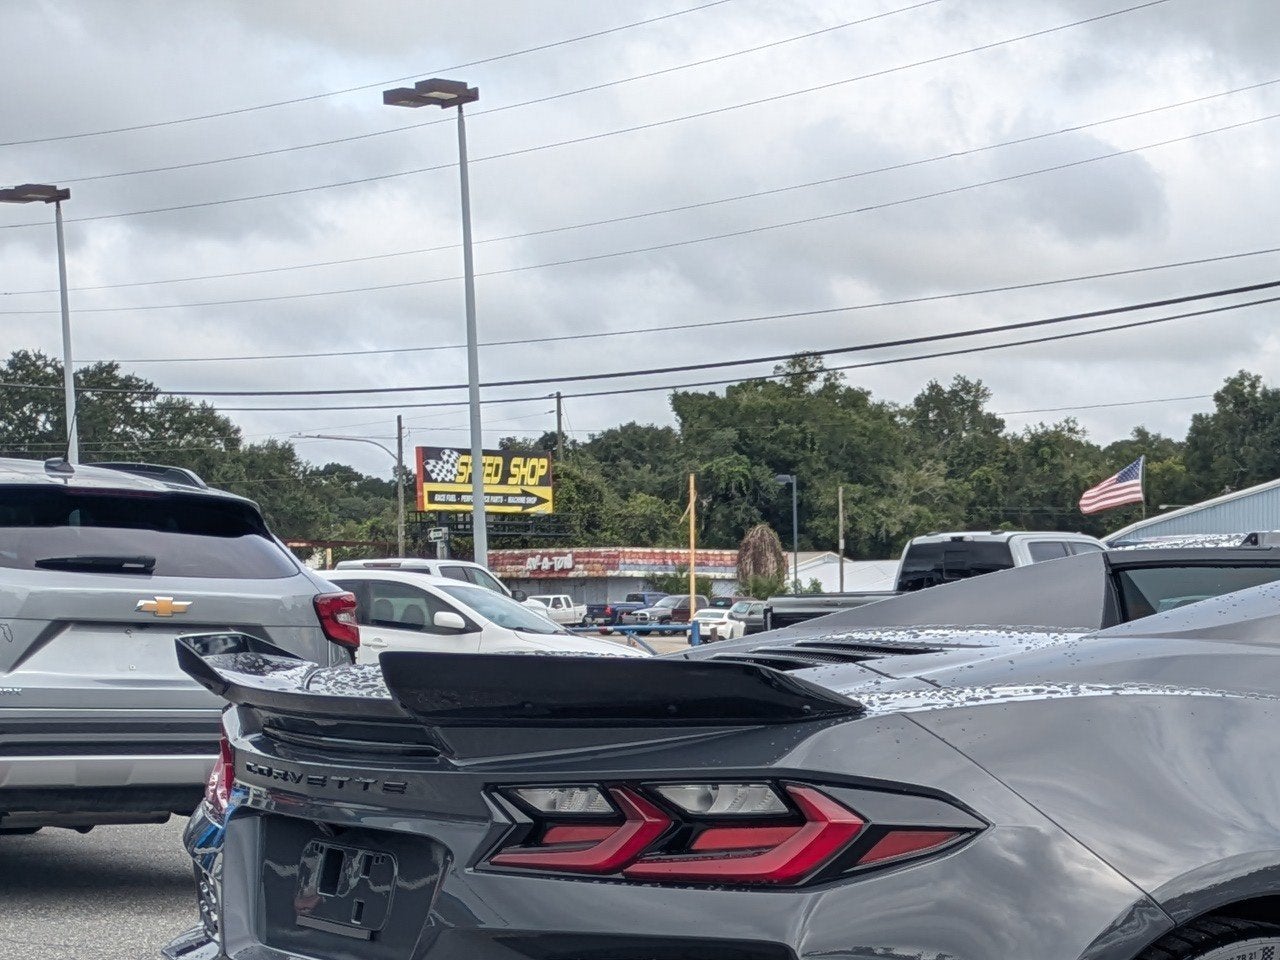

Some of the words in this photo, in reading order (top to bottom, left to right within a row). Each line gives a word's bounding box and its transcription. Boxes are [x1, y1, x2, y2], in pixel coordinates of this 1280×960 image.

[455, 455, 503, 484] SPED
[508, 457, 548, 485] SHOP
[246, 762, 408, 795] CORVETTE
[1249, 951, 1257, 960] 21
